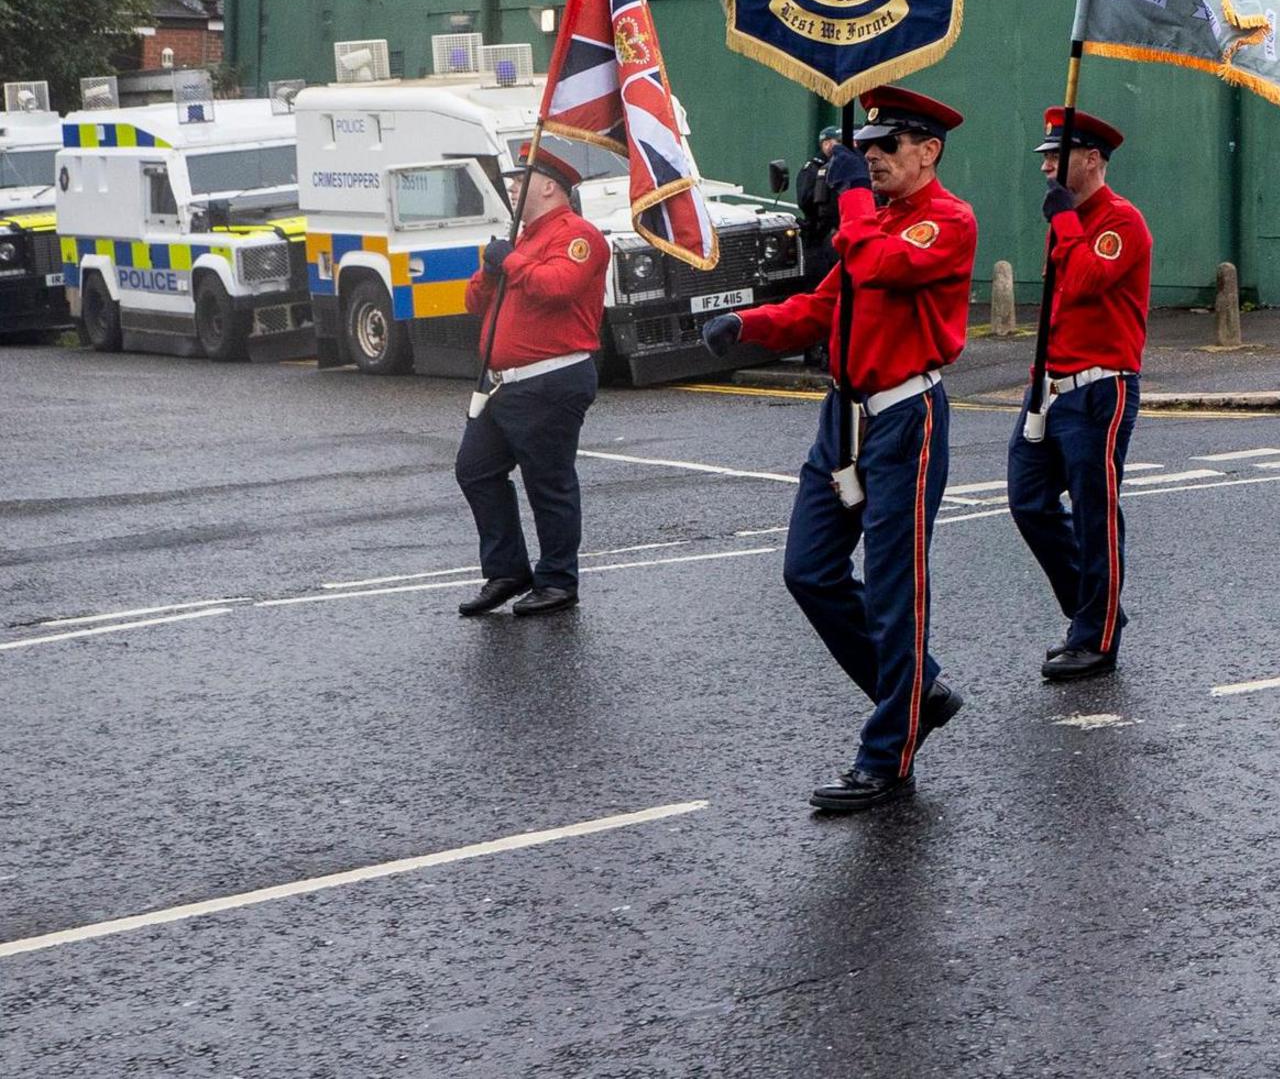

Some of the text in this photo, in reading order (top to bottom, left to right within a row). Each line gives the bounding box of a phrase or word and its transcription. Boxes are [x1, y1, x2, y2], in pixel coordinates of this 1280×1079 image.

[336, 119, 365, 133] POLICE
[312, 171, 380, 189] CRIMESTOPPERS
[119, 270, 178, 291] POLICE
[702, 293, 743, 310] IFZ 4115
